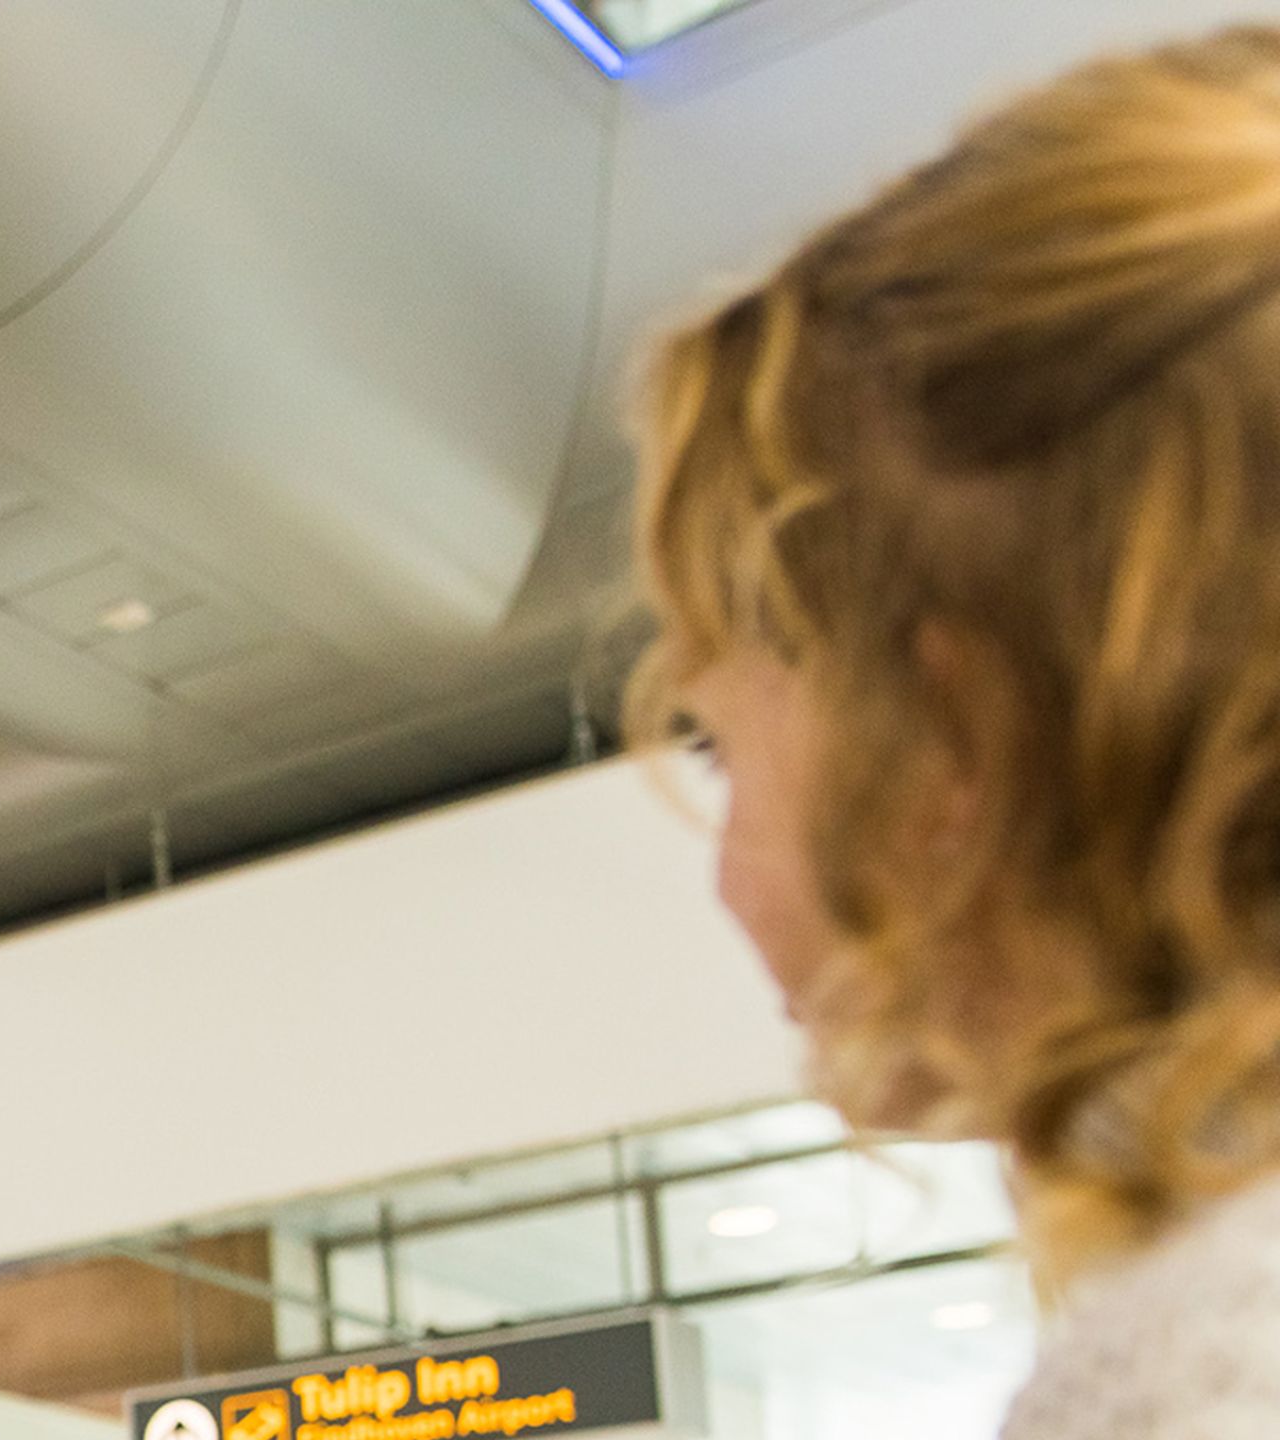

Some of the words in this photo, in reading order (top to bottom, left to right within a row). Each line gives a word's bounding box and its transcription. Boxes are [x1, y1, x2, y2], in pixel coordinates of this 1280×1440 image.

[292, 1363, 411, 1422] Tulip
[416, 1355, 500, 1405] Inn
[456, 1387, 576, 1436] Airport
